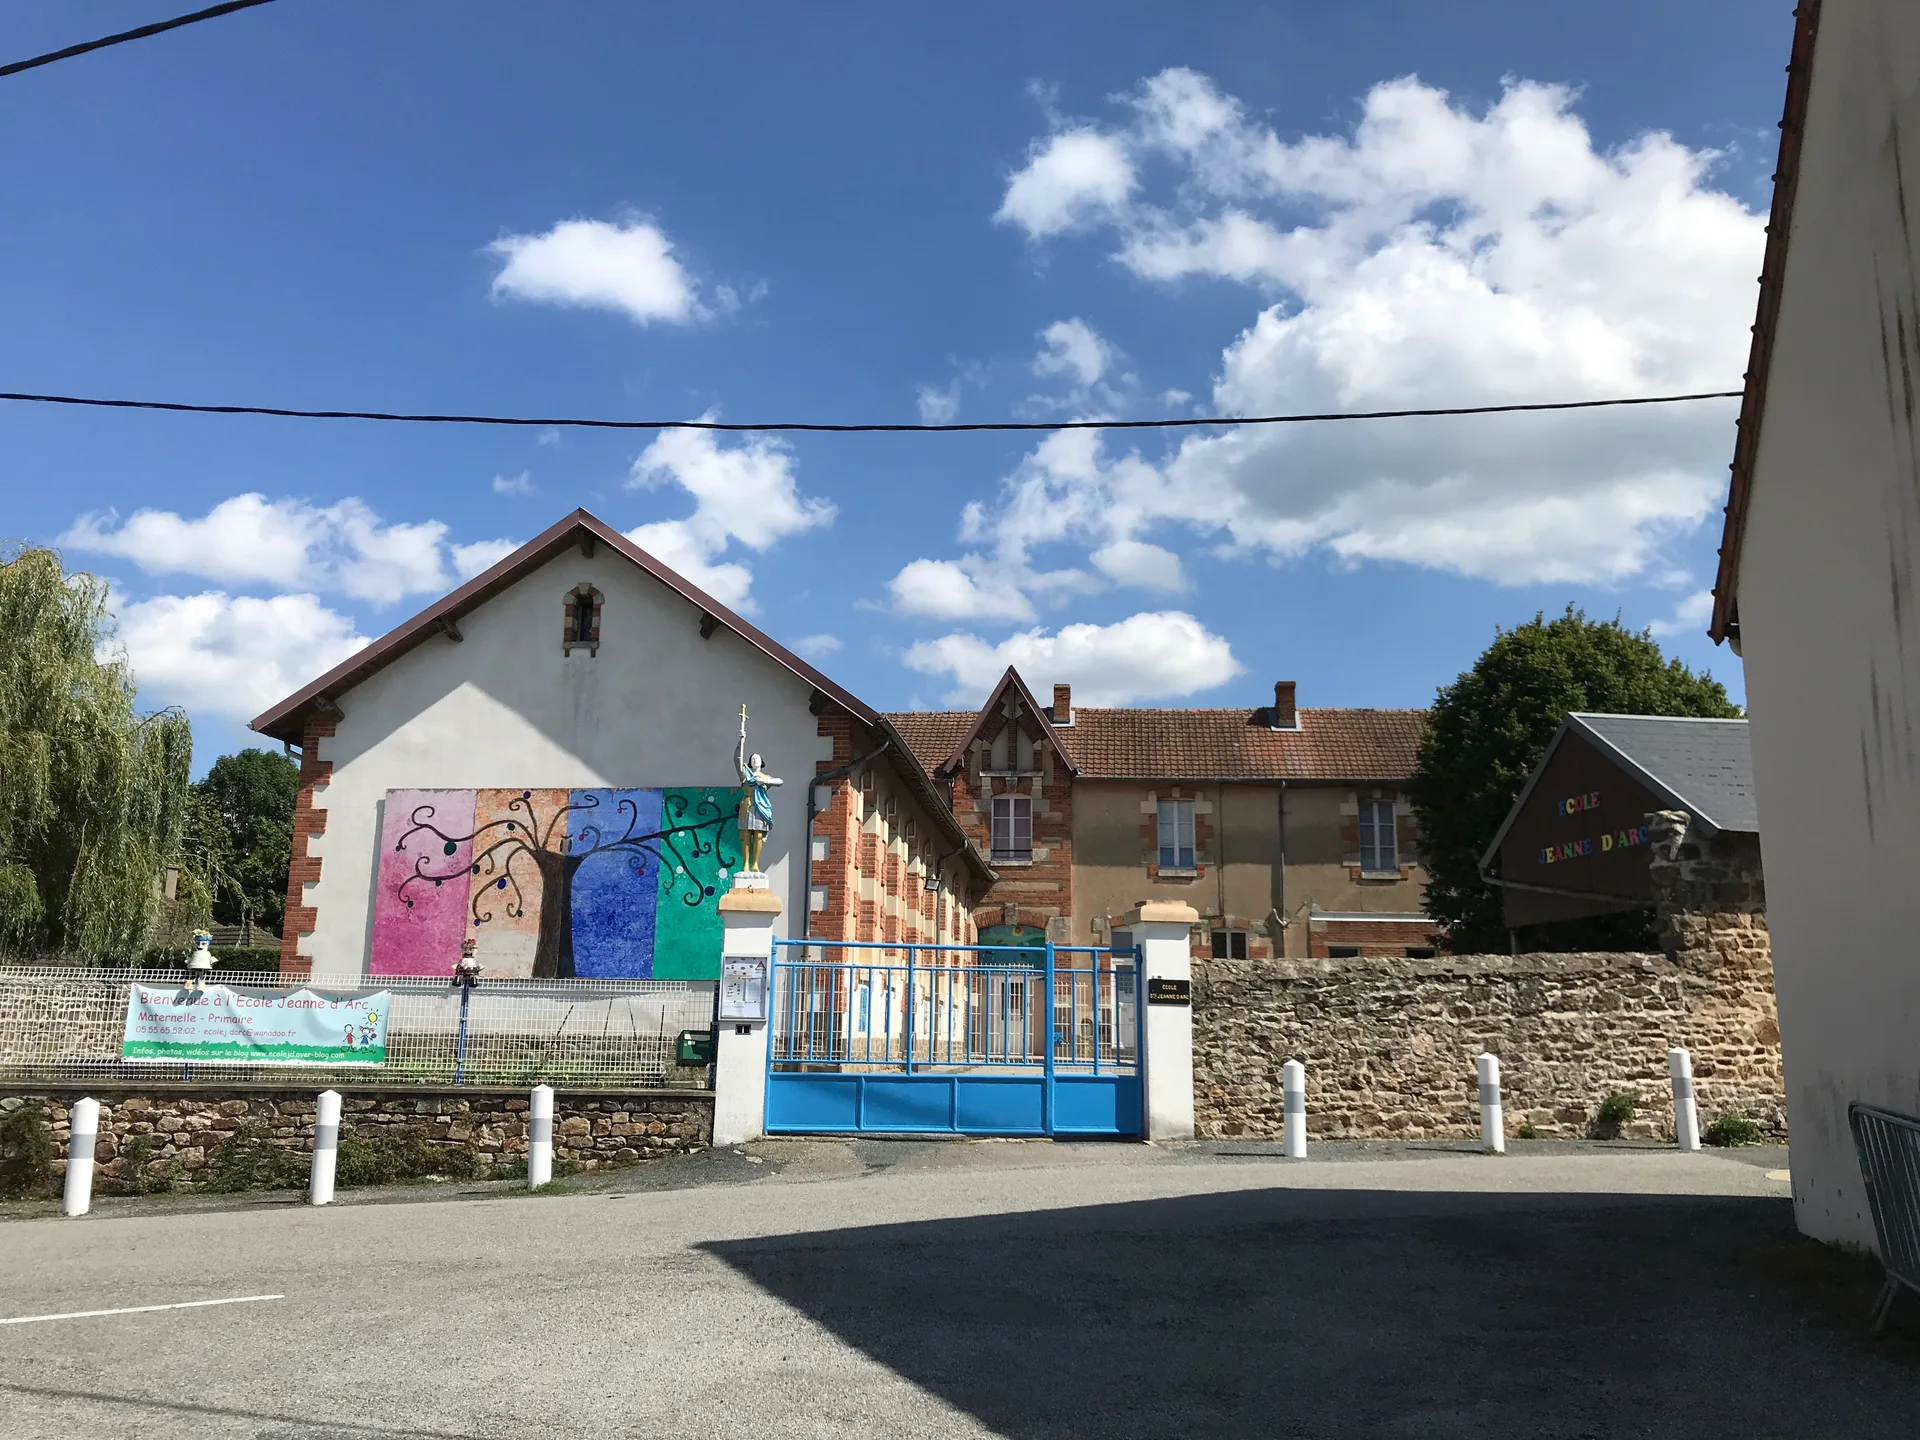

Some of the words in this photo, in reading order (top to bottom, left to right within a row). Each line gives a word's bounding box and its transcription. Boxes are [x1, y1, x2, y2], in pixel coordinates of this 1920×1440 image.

[1558, 791, 1599, 817] ECOLE
[1539, 838, 1592, 864] JEANNE
[1600, 825, 1648, 852] D'ARC
[140, 992, 209, 1006] Bienvenue
[213, 993, 222, 1007] à
[225, 993, 273, 1009] l'Ecole
[277, 996, 325, 1009] Jeanne
[329, 997, 369, 1011] d'Arc
[138, 1012, 196, 1023] Maternelle
[208, 1012, 253, 1025] Primaire
[203, 1027, 296, 1038] ecolej.darc@wanadoo.fr
[132, 1046, 156, 1055] Infos,
[157, 1047, 185, 1057] photos,
[186, 1048, 210, 1057] vidéos
[225, 1048, 233, 1057] le
[233, 1048, 250, 1059] blog
